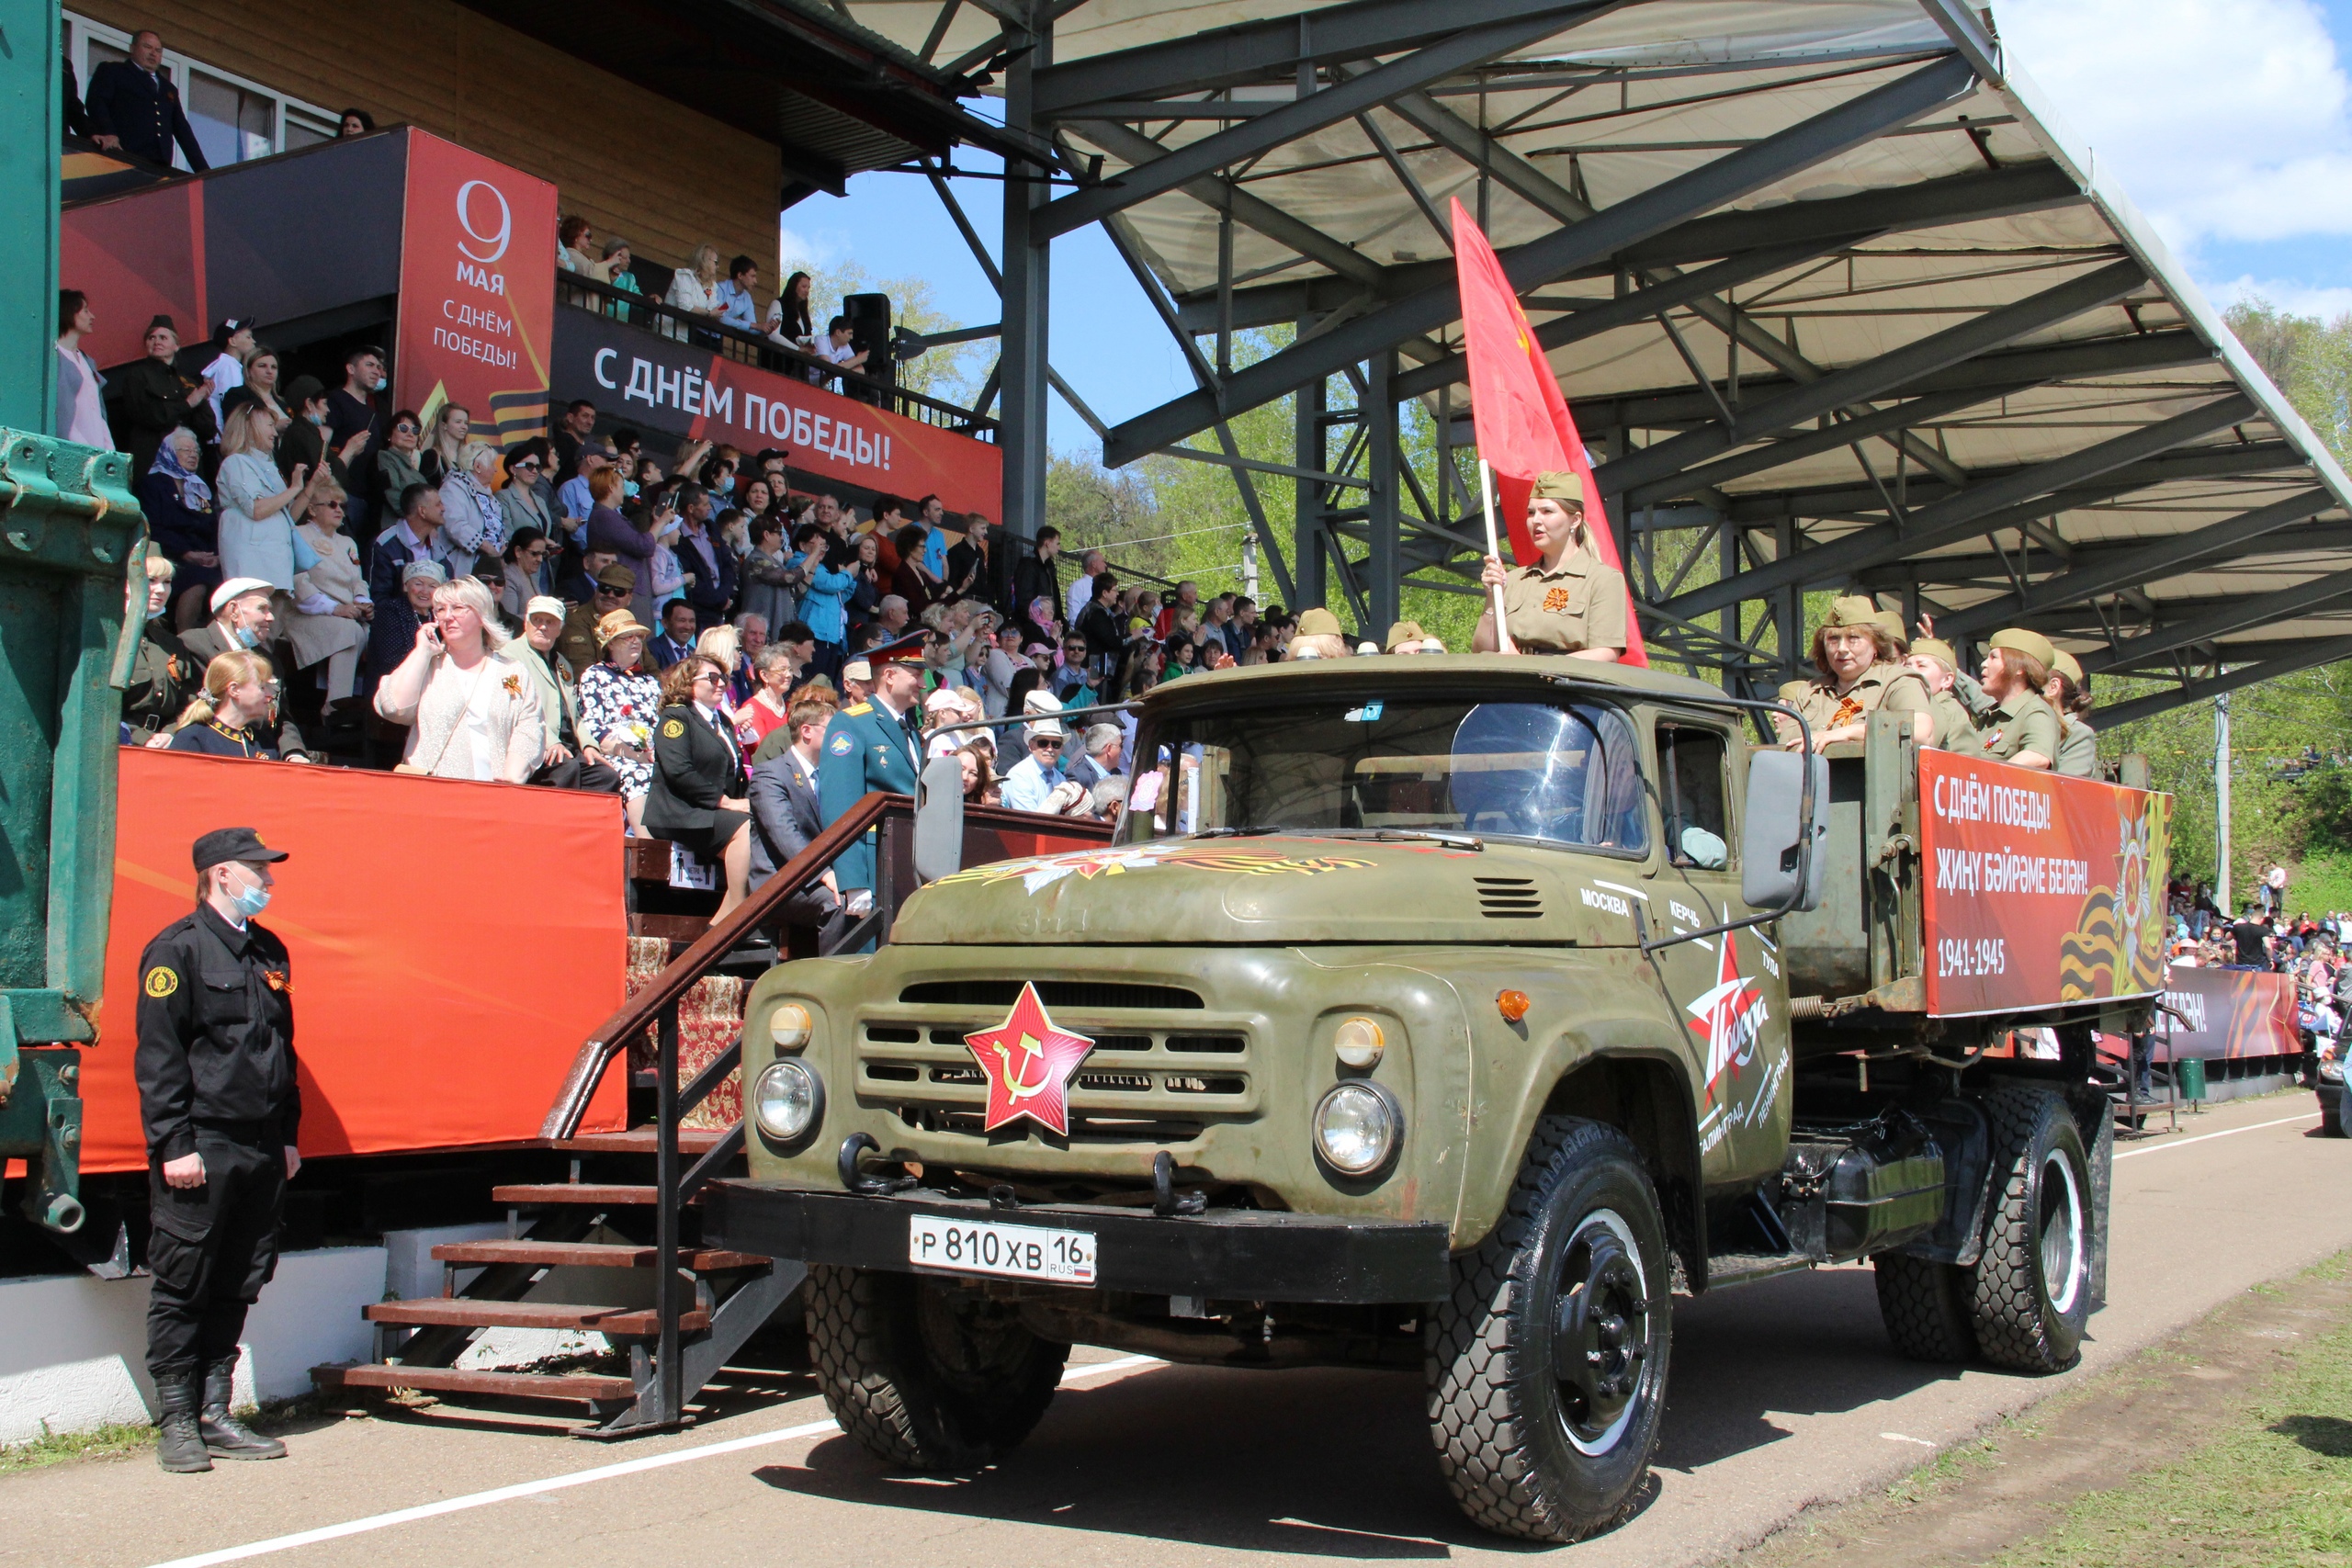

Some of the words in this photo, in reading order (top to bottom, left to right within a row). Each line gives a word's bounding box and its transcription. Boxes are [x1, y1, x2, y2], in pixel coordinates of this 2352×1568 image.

[456, 179, 512, 264] 9
[456, 260, 505, 296] МАЯ
[443, 299, 455, 320] С
[457, 303, 512, 338] ДНЁМ
[433, 326, 517, 370] ПОБЕДЫ!
[594, 347, 618, 389] С
[624, 356, 734, 425] ДНЁМ
[744, 392, 891, 471] ПОБЕДЫ!
[1933, 773, 1946, 817] С
[1948, 773, 1990, 825] ДНЁМ
[1993, 785, 2051, 835] ПОБЕДЫ!
[1984, 845, 2046, 895] БӘЙРӘМЕ
[2048, 858, 2088, 896] БЕЛӘН!
[1579, 887, 1630, 918] МОСКВА
[1668, 899, 1701, 929] КЕРЧЬ
[1761, 950, 1781, 980] ТУЛА
[1938, 938, 2005, 977] 1941-1945
[1757, 1047, 1790, 1129] ЛЕНИНГРАД
[1049, 1263, 1073, 1275] RUS
[1053, 1235, 1083, 1264] 16
